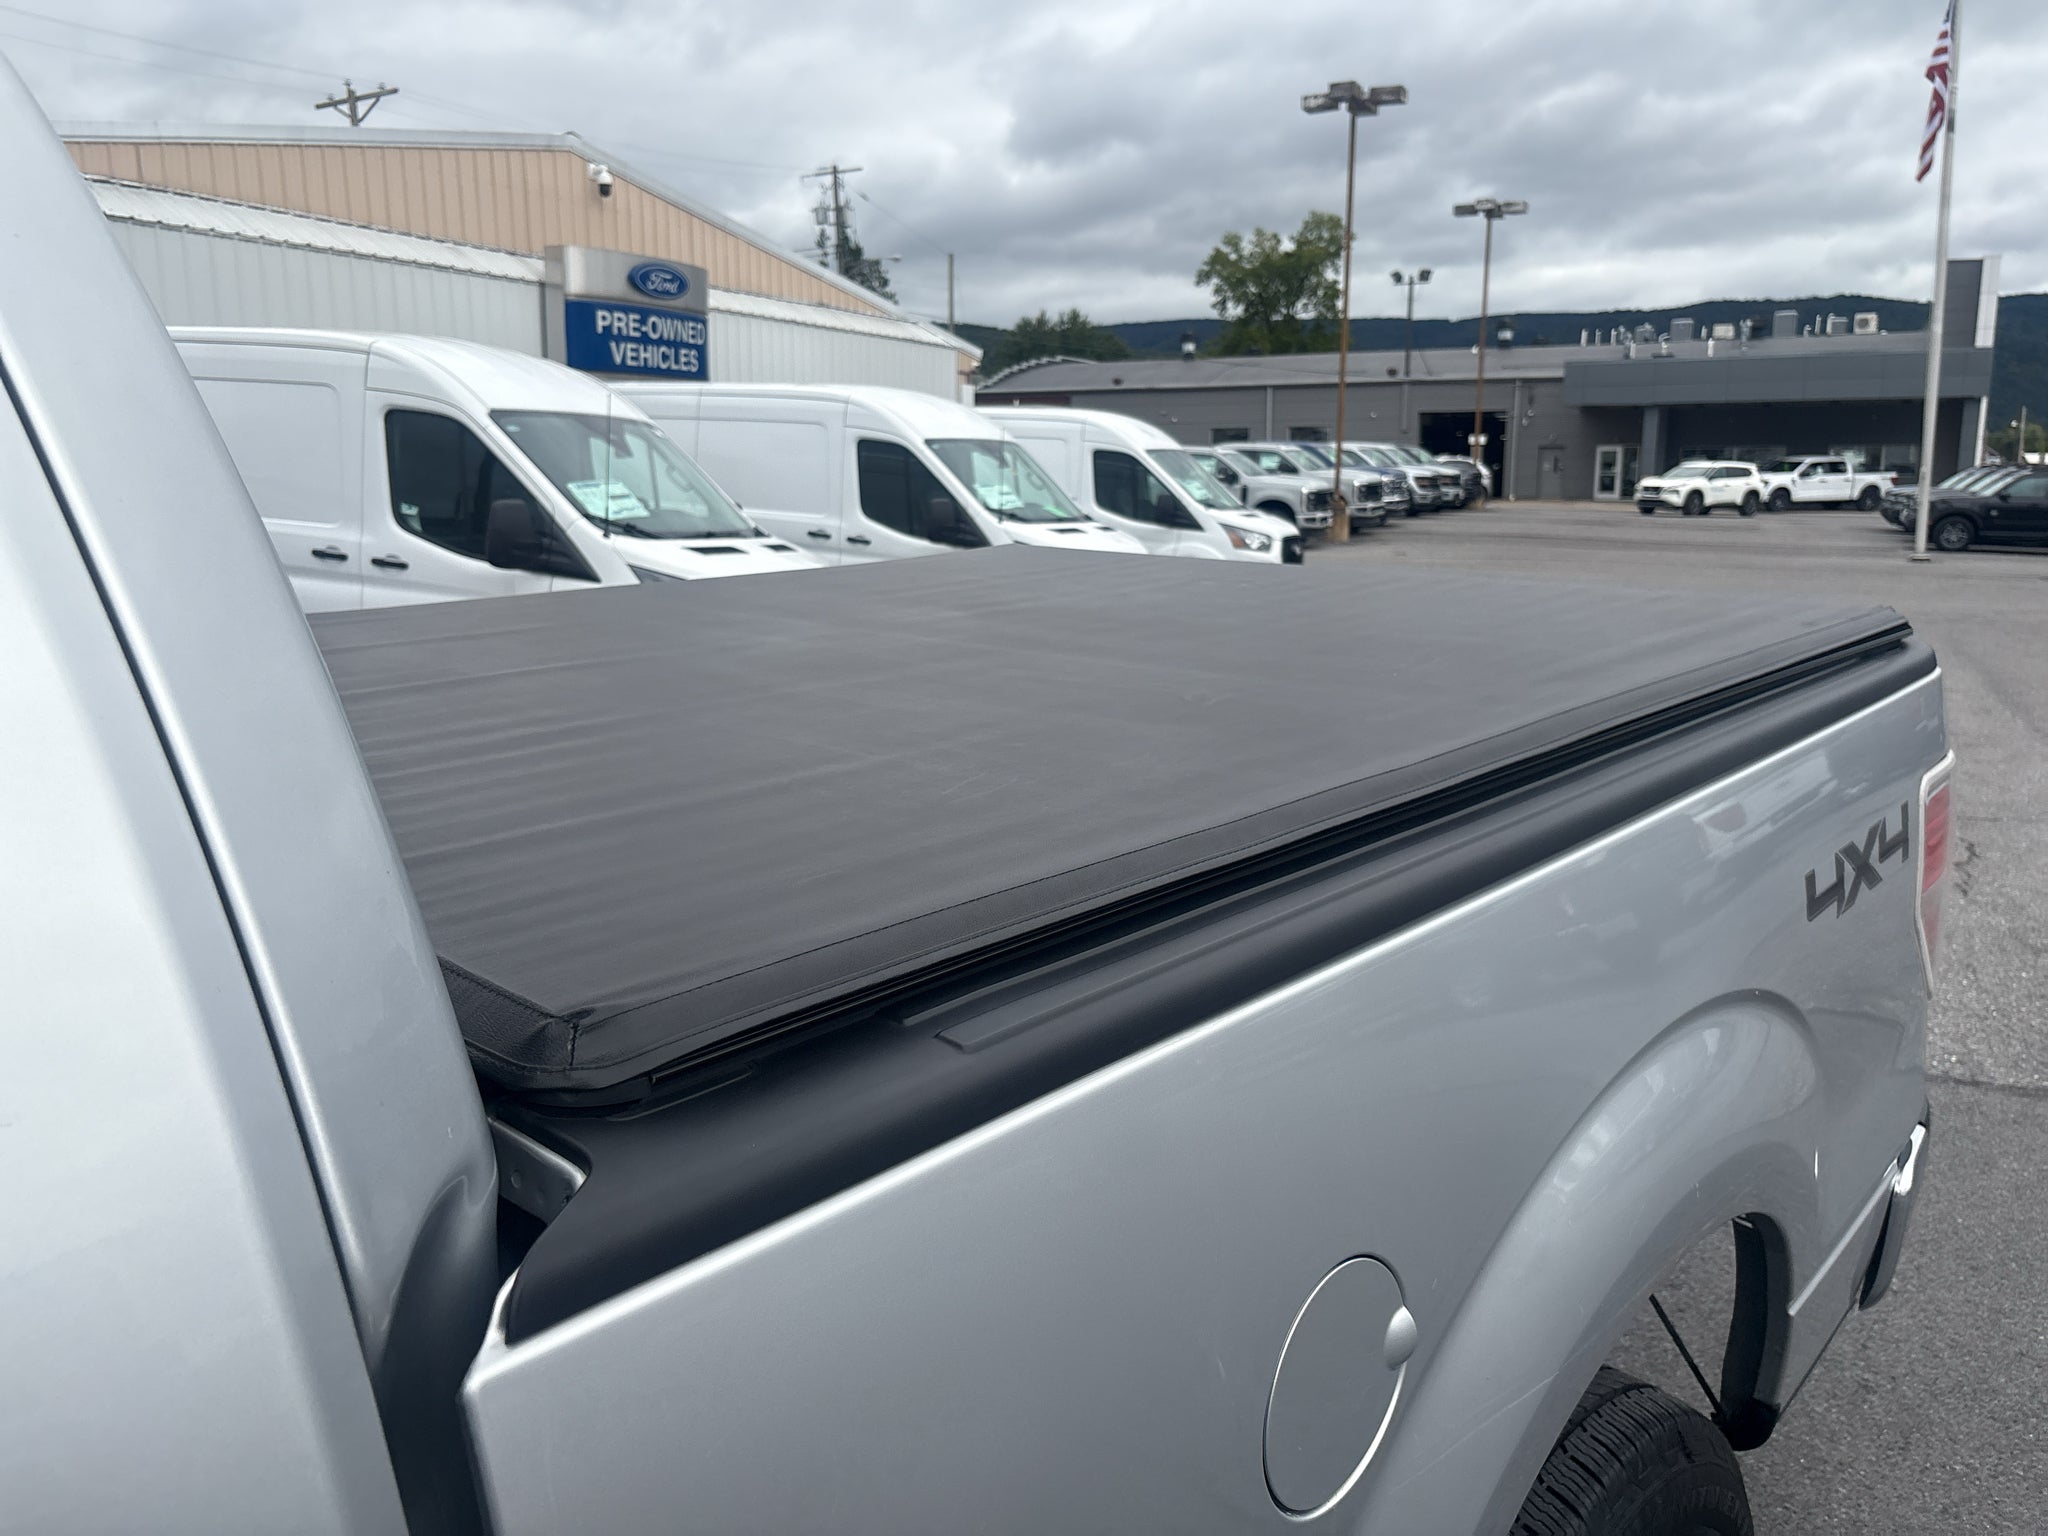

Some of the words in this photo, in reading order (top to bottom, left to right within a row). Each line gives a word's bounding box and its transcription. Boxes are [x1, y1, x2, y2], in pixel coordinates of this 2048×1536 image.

[647, 272, 680, 294] Ford
[595, 309, 705, 346] PRE-OWNED
[609, 340, 699, 373] VEHICLES
[1805, 800, 1909, 922] 4X4
